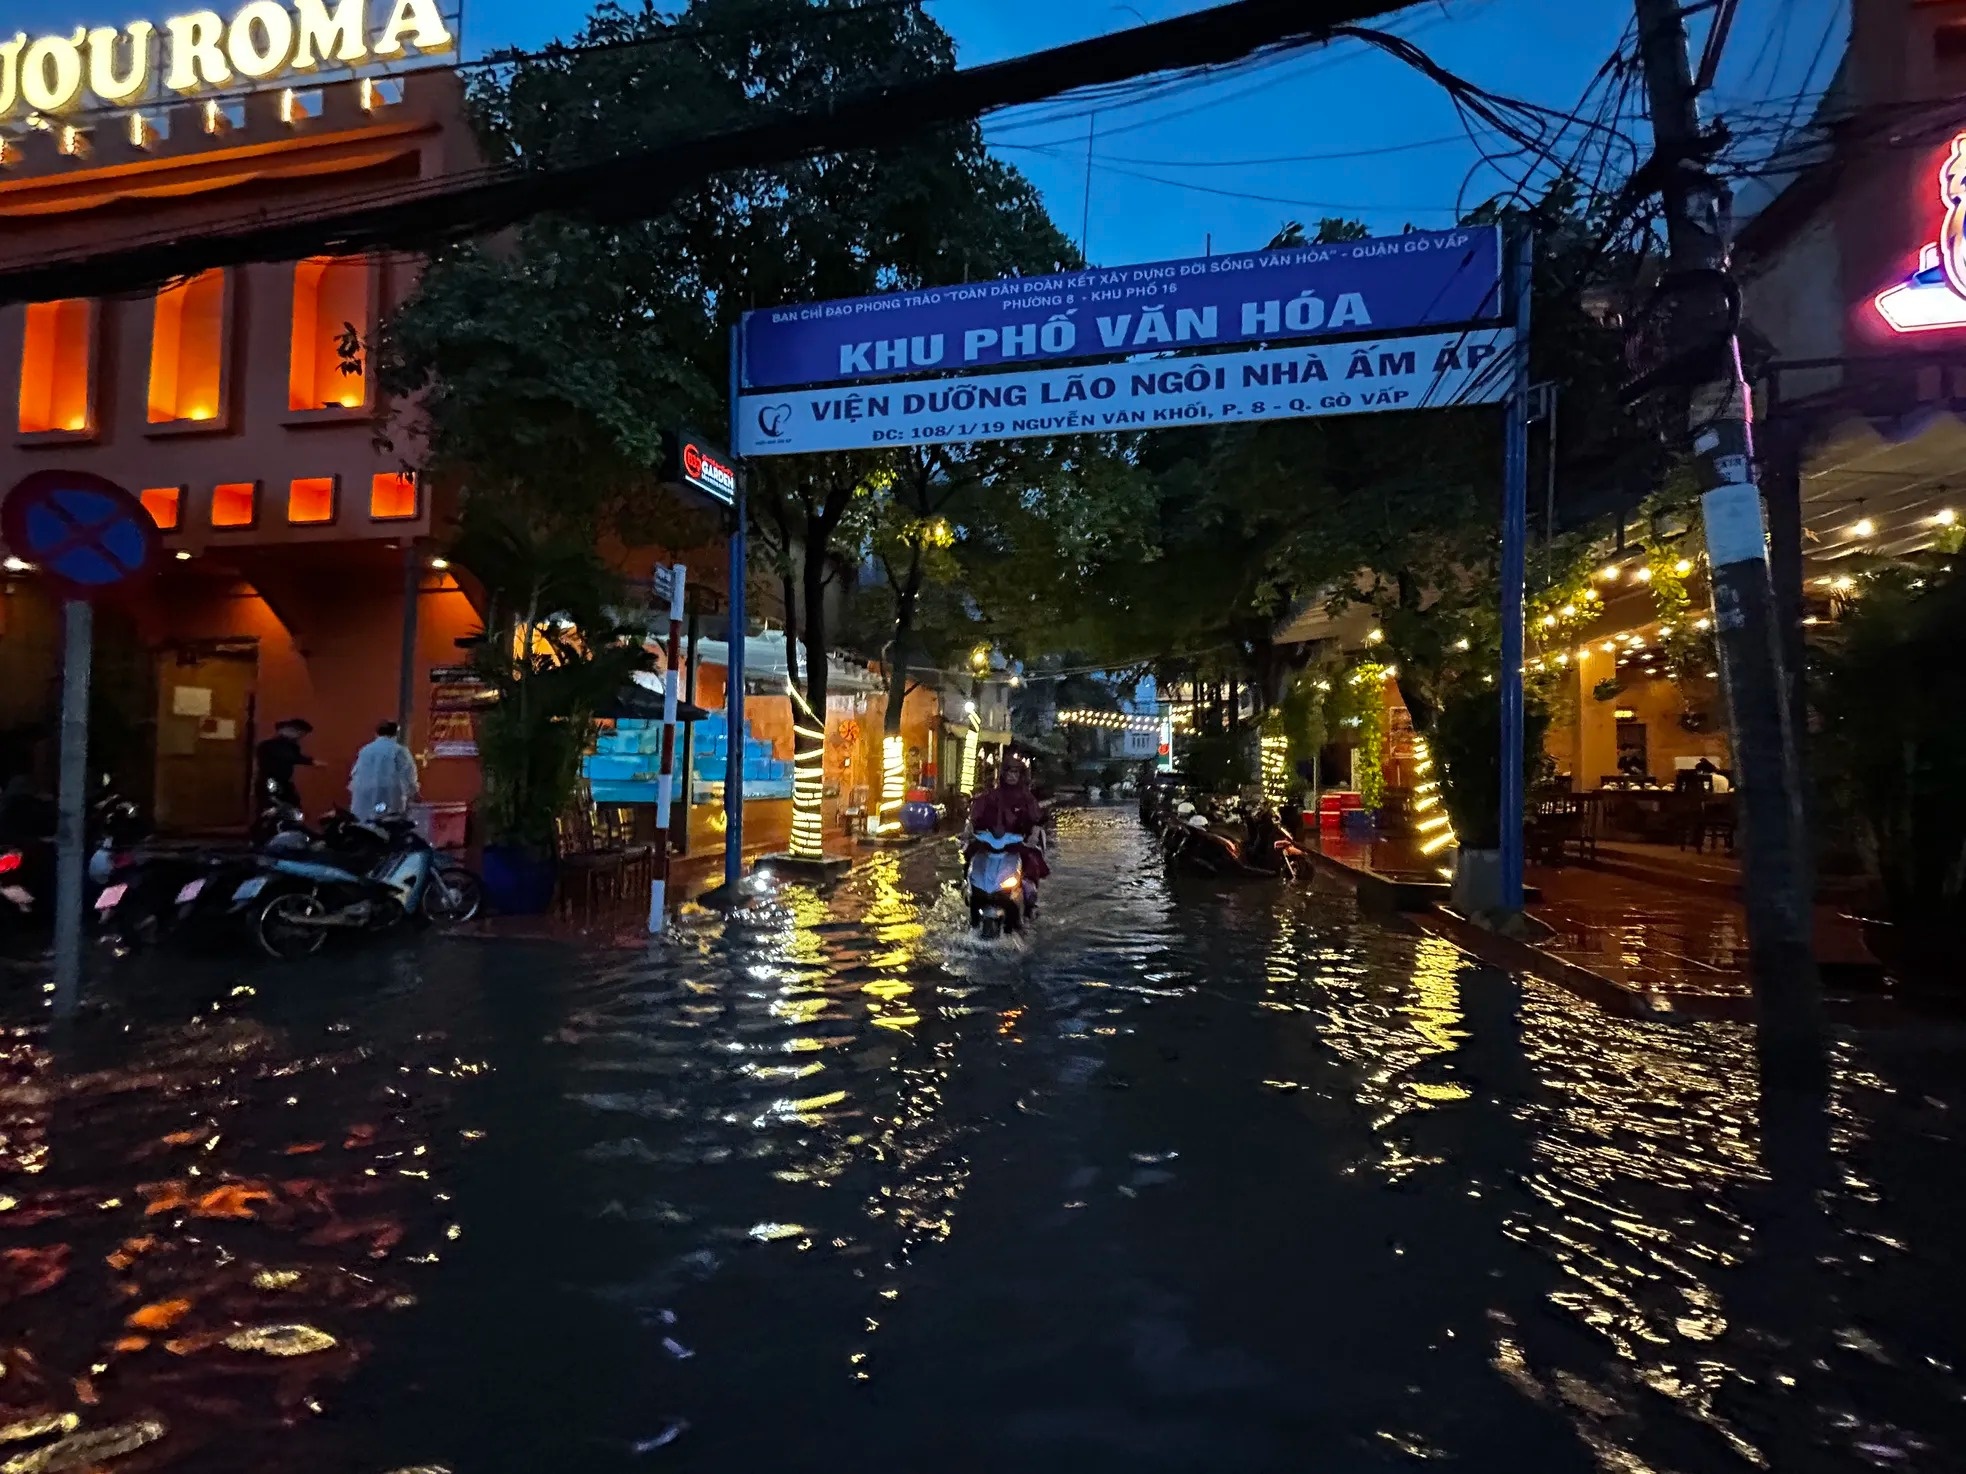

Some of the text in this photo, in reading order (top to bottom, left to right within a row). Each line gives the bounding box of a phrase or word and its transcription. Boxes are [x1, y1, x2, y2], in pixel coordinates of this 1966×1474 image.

[164, 0, 453, 92] ROMA
[772, 312, 797, 323] BAN
[855, 299, 901, 313] PHONG
[991, 281, 1020, 296] DÂN
[1023, 278, 1063, 293] ĐOÀN
[1067, 271, 1095, 288] KẾT
[1100, 272, 1129, 285] XÂY
[1133, 267, 1176, 282] DỰNG
[1180, 262, 1206, 277] ĐỜI
[1210, 257, 1254, 273] SỐNG
[1259, 253, 1290, 267] VĂN
[1352, 243, 1399, 260] QUẬN
[1405, 238, 1430, 253] GÒ
[1434, 233, 1469, 249] VẤP
[1003, 294, 1062, 311] PHƯỜNG
[1066, 293, 1075, 304] 8
[1091, 288, 1122, 302] KHU
[1126, 282, 1158, 298] PHỐ
[1162, 283, 1177, 294] 16
[840, 288, 1373, 374] KHU PHỐ VĂN HÓA
[811, 340, 1497, 422] VIỆN DƯỠNG LÃO NGÔI NHÀ ẤM ÁP
[872, 429, 904, 441] ĐC:
[1013, 409, 1095, 432] NGUYỄN
[1102, 408, 1145, 425] VĂN
[1153, 401, 1213, 421] KHỐI,
[1223, 403, 1243, 417] P.
[1251, 401, 1266, 414] 8
[1289, 398, 1311, 412] Q.
[1320, 391, 1352, 408] GÒ
[1360, 386, 1409, 406] VẤP
